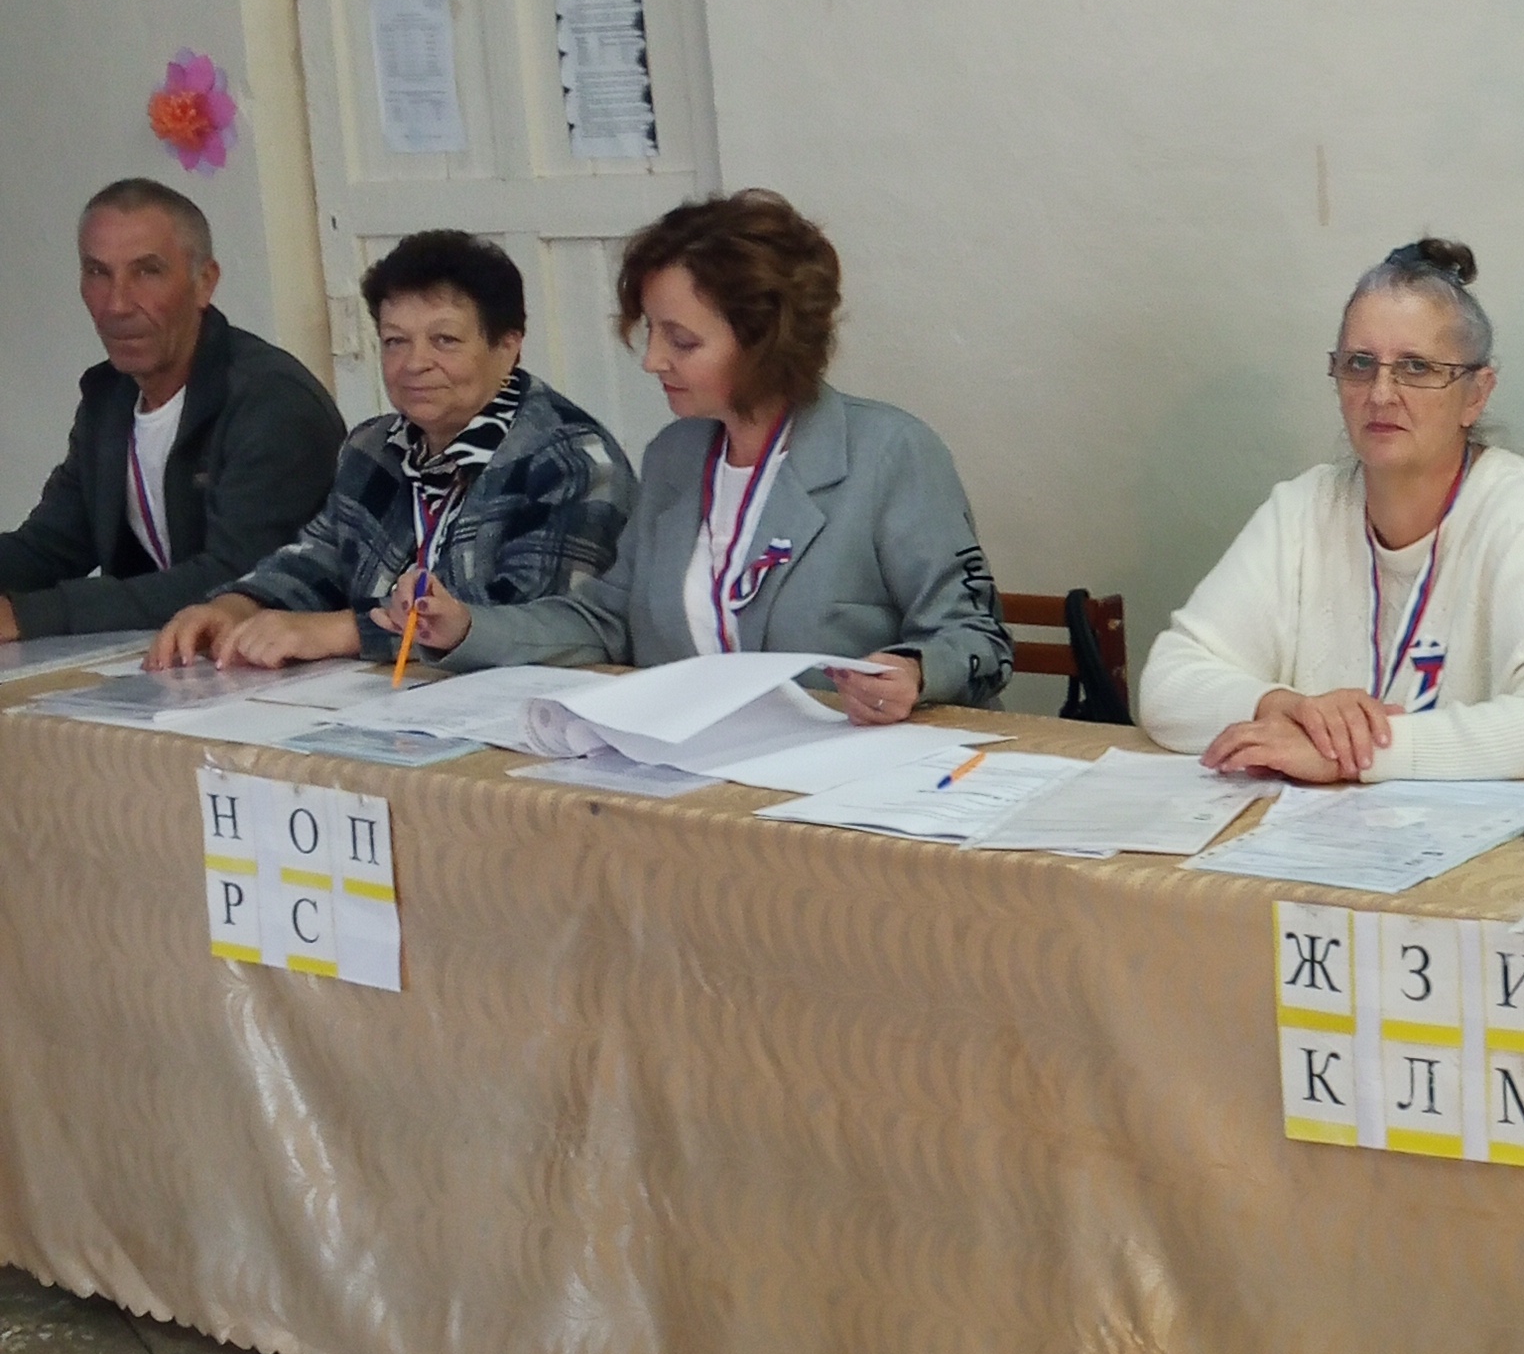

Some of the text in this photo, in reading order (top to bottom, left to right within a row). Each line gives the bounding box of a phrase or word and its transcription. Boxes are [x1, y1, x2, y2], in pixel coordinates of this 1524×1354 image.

[207, 793, 380, 866] Н О П
[220, 880, 320, 944] Р С
[1285, 931, 1342, 993] Ж
[1400, 944, 1432, 1001] З
[1300, 1047, 1346, 1106] К
[1396, 1056, 1443, 1115] Л
